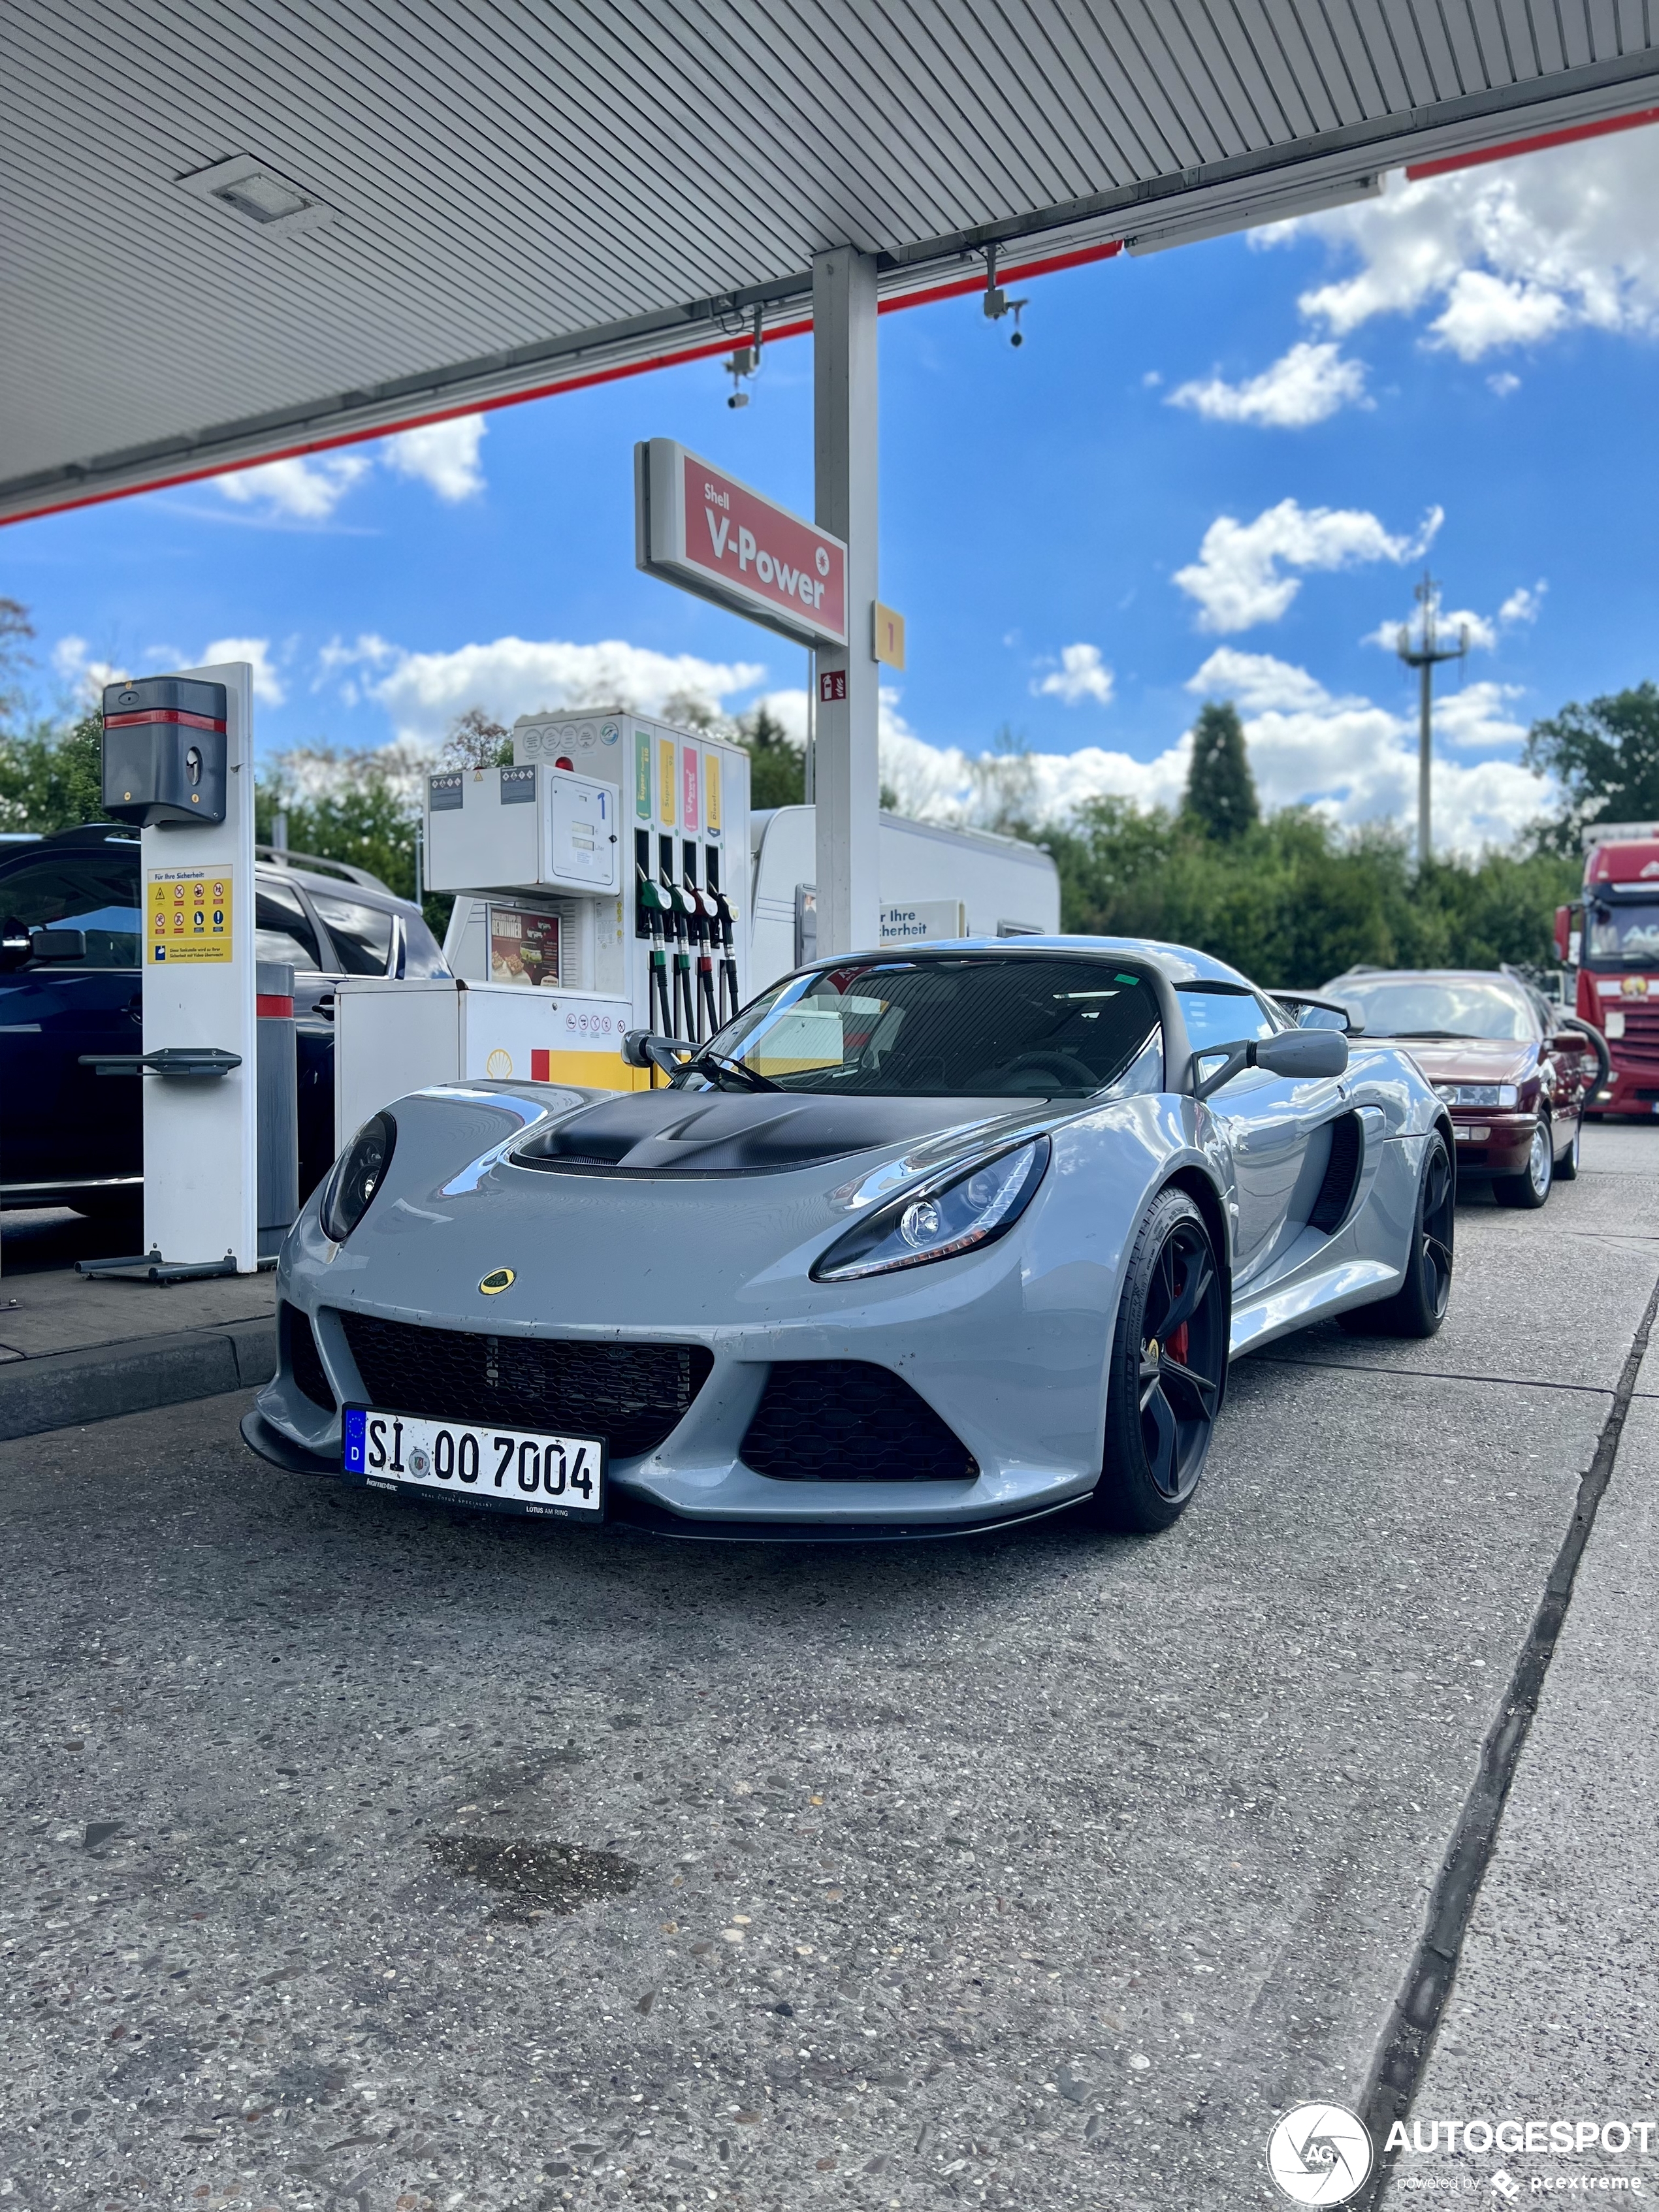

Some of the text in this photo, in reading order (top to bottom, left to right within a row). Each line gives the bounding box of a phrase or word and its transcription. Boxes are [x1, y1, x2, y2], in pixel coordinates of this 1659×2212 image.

[704, 483, 730, 511] Shell
[704, 505, 826, 611] V-Power
[887, 622, 895, 653] 1
[597, 792, 605, 820] 1
[890, 908, 916, 922] Ihre
[351, 1447, 359, 1461] D
[368, 1420, 405, 1473] SI
[494, 1436, 593, 1500] 7004
[526, 1505, 544, 1514] LOTUS
[554, 1509, 569, 1517] RING
